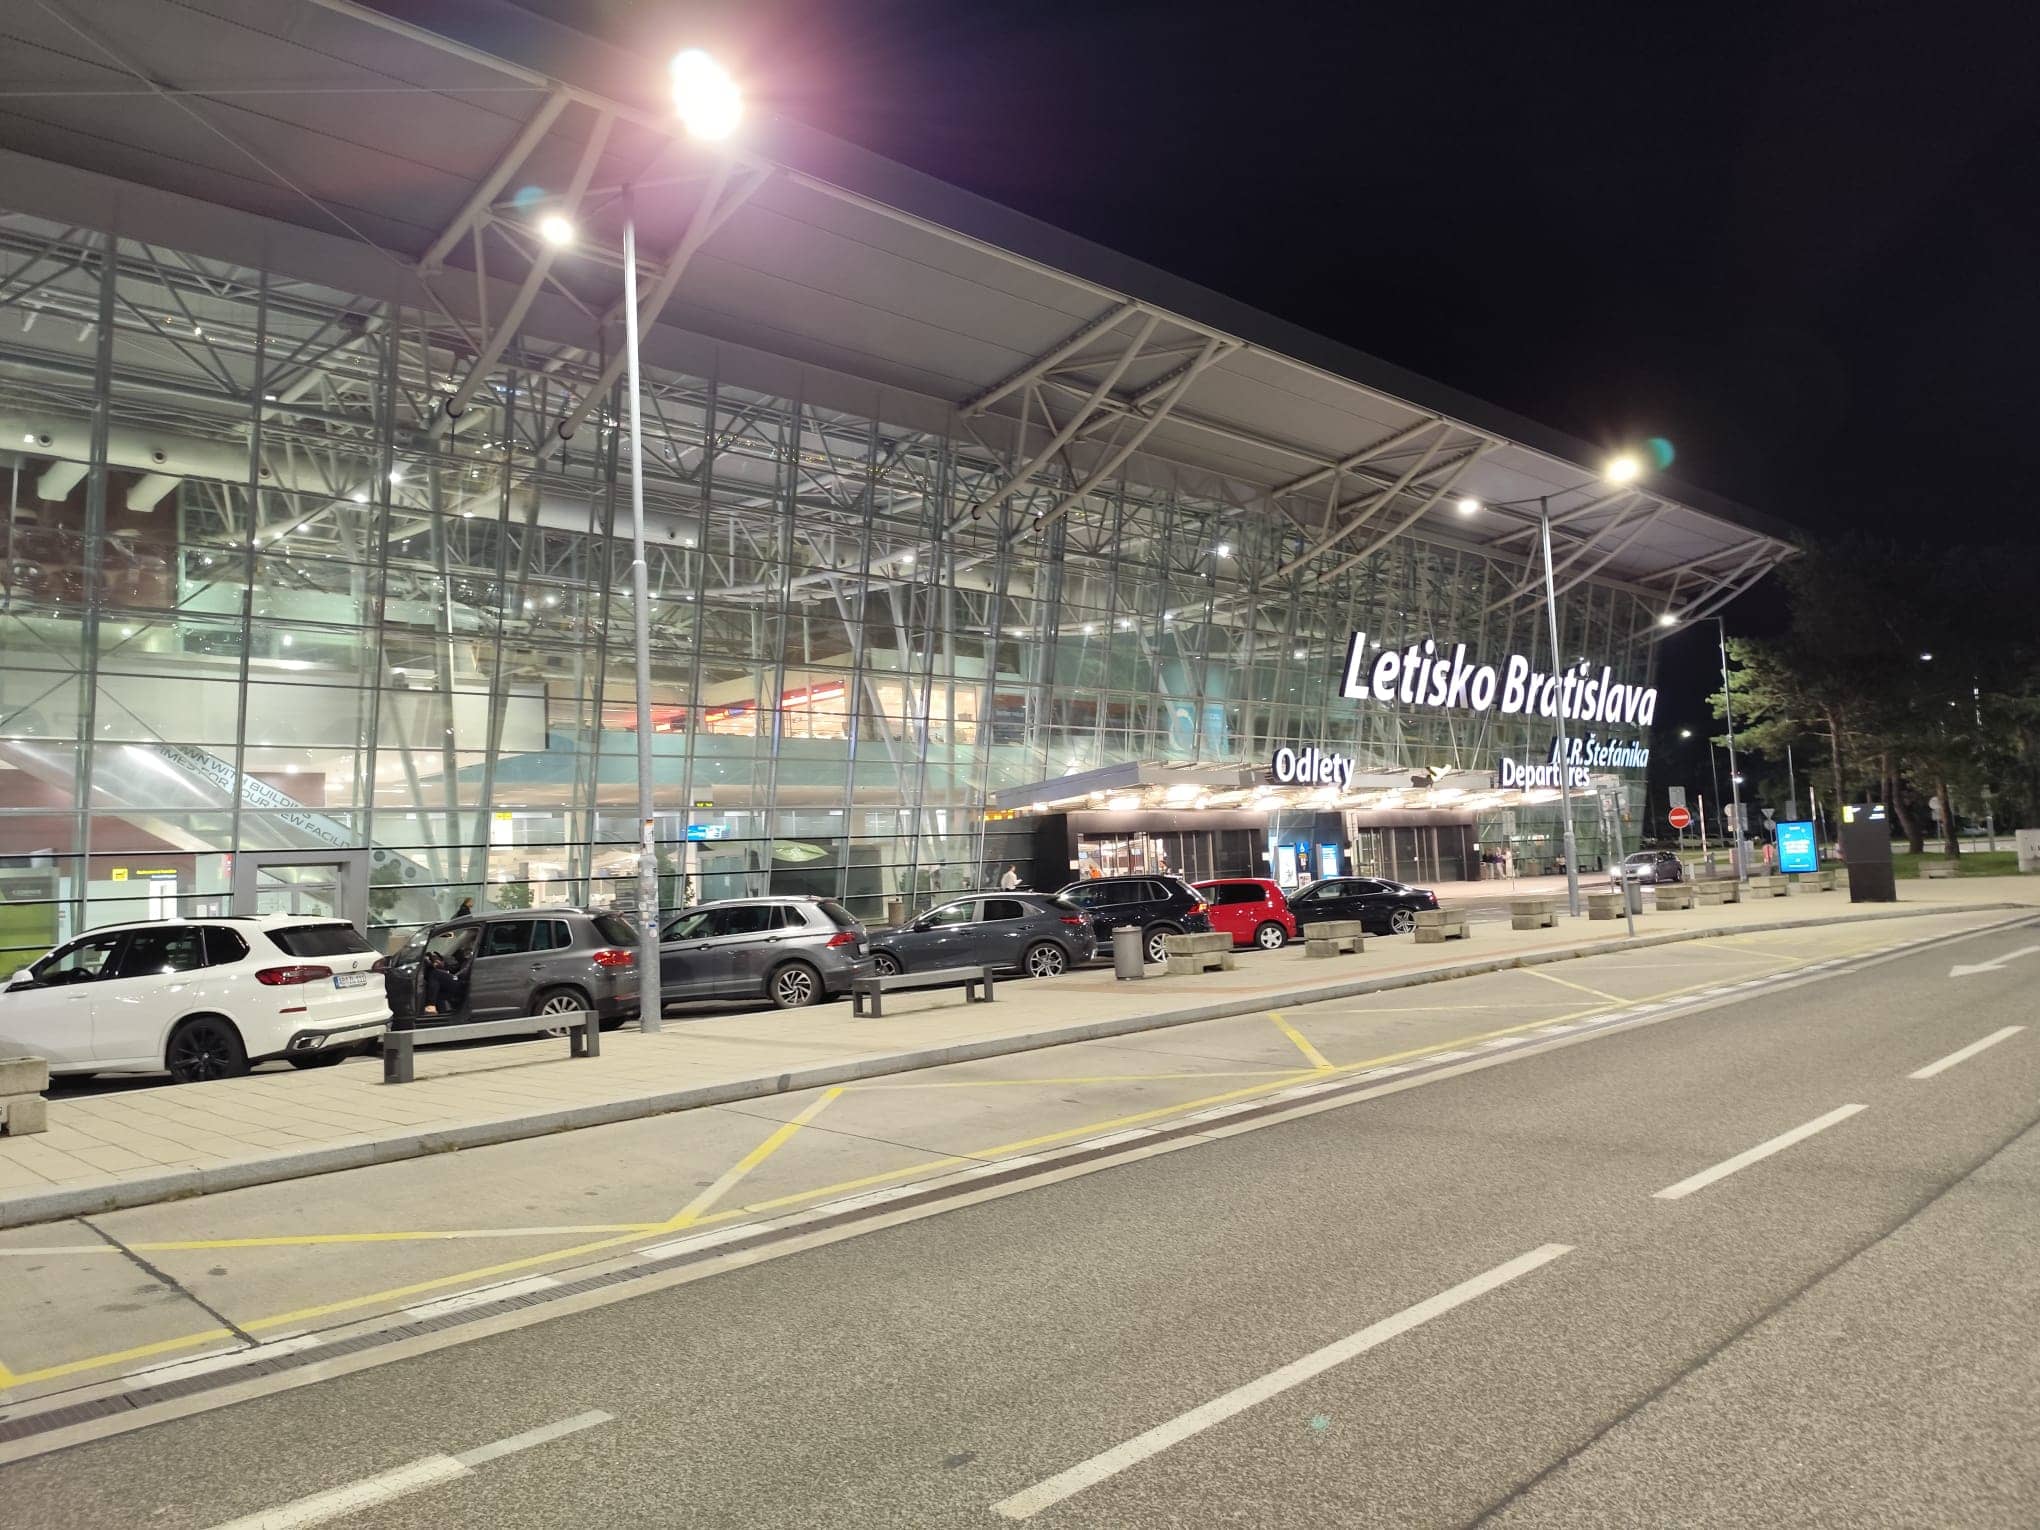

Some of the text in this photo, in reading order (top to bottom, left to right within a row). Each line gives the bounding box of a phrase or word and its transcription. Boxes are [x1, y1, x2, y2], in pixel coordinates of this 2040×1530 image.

[1344, 631, 1658, 726] Letisko Bratislava
[1276, 747, 1355, 791] Odlety
[1502, 757, 1590, 791] Departres
